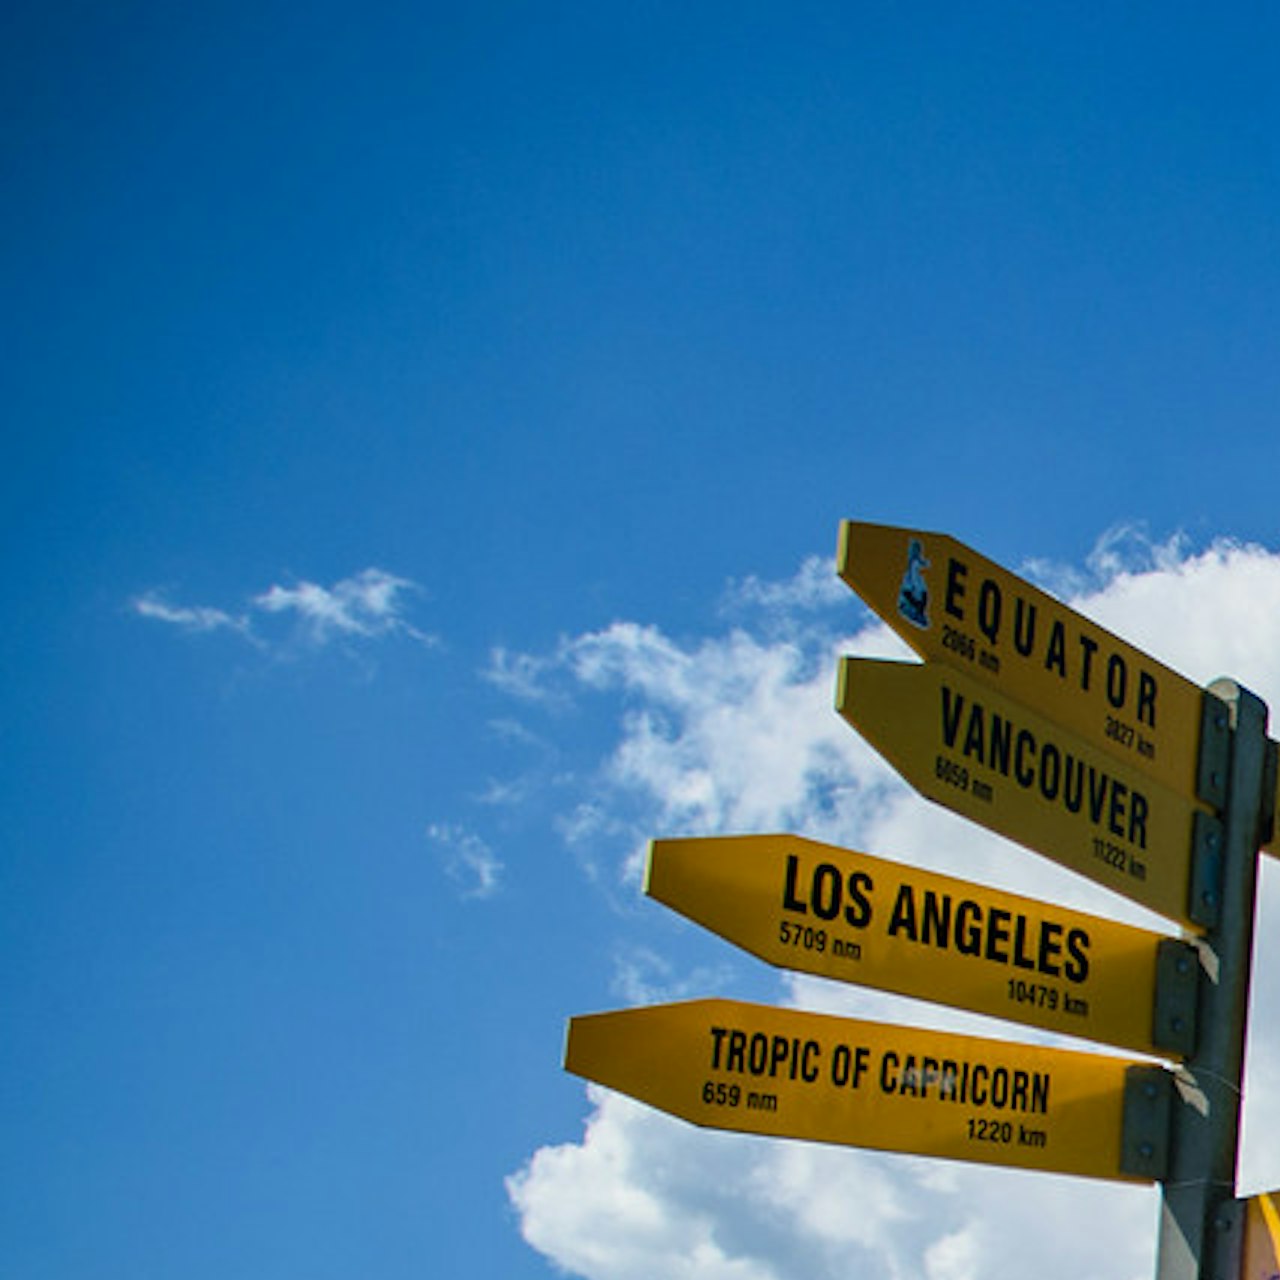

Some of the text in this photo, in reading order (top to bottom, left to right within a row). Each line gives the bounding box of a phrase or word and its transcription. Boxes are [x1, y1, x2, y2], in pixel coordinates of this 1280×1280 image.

[945, 557, 1158, 730] EQUATOR
[1137, 733, 1155, 760] km
[941, 686, 1148, 850] VANCOUVER
[1128, 855, 1147, 882] km
[783, 854, 1090, 985] LOS ANGELES
[779, 921, 861, 960] 5709 nm
[1008, 978, 1090, 1017] 10479 km
[711, 1026, 1050, 1115] TROPIC OF CAPRICORN
[702, 1081, 777, 1114] 659 nm
[968, 1119, 1048, 1148] 1220 km
